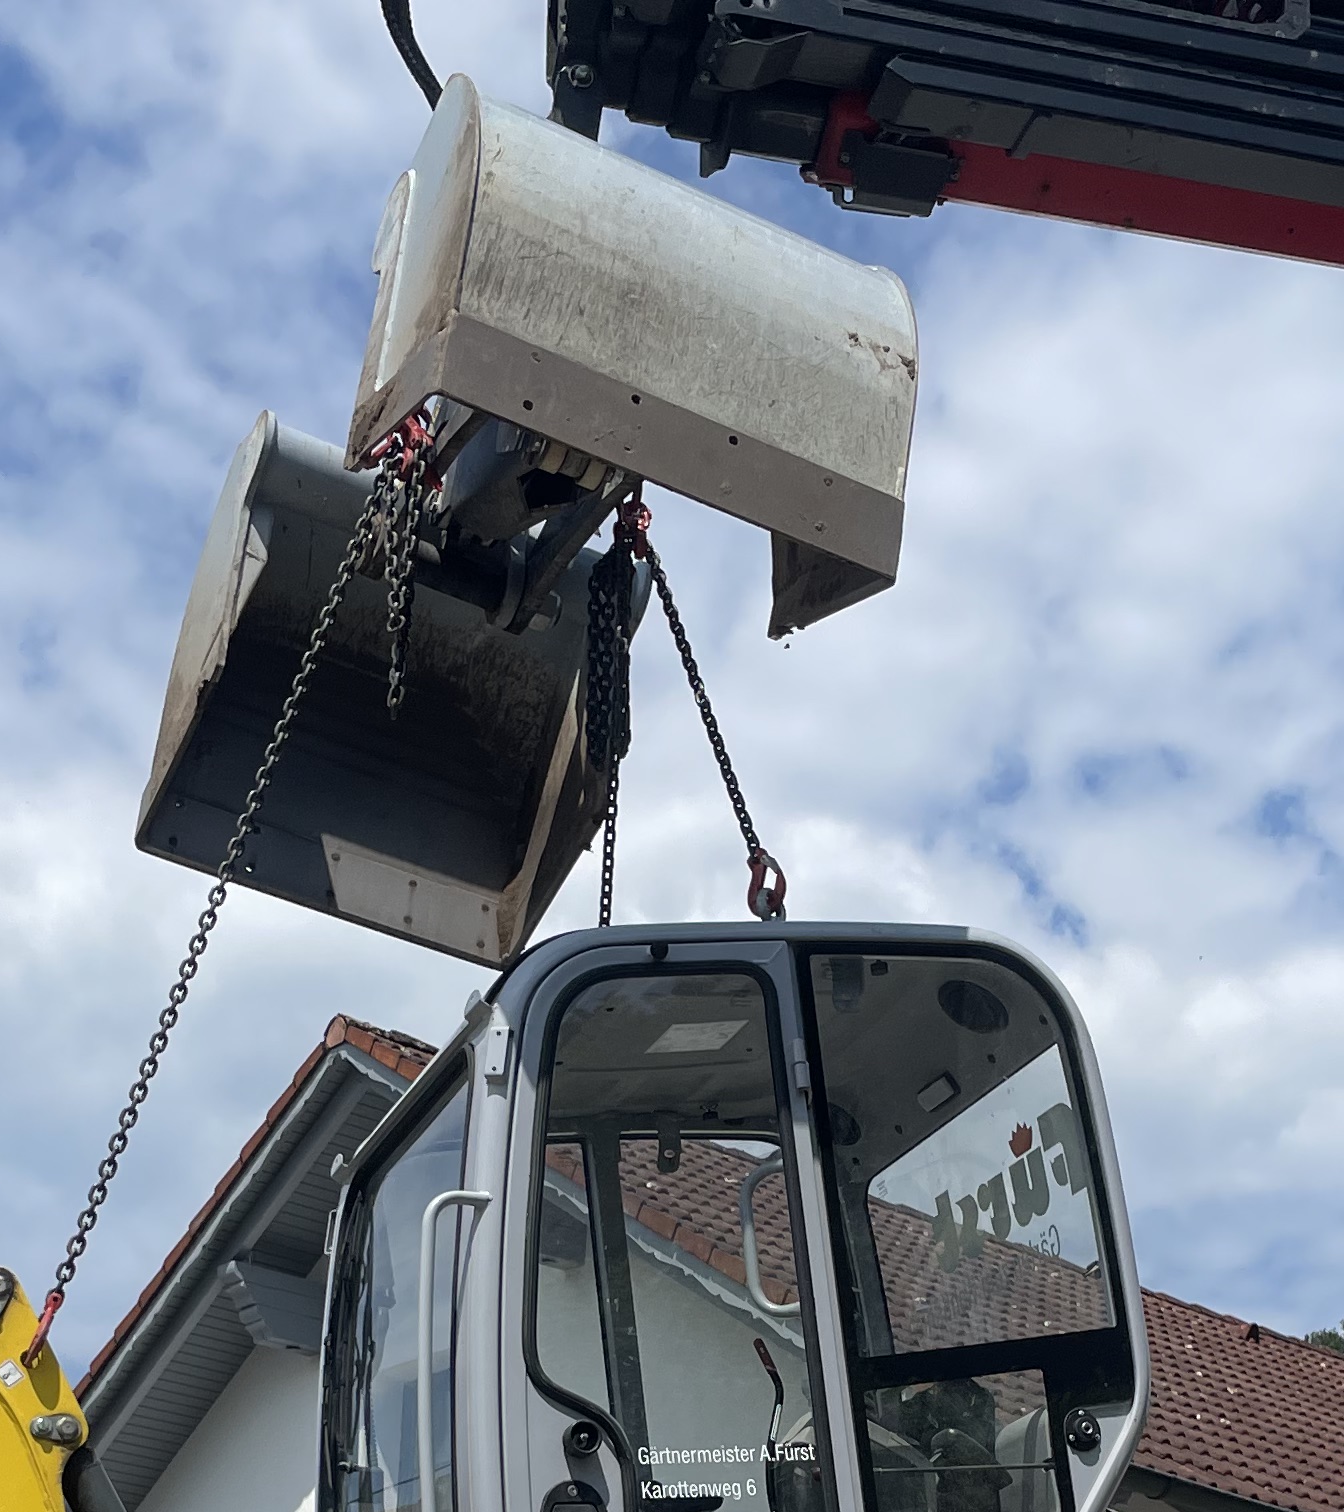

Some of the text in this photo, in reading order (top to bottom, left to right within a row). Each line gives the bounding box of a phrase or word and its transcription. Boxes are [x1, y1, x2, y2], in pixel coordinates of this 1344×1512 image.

[637, 1443, 756, 1465] Gärtnermeister
[640, 1478, 757, 1500] Karottenweg 6
